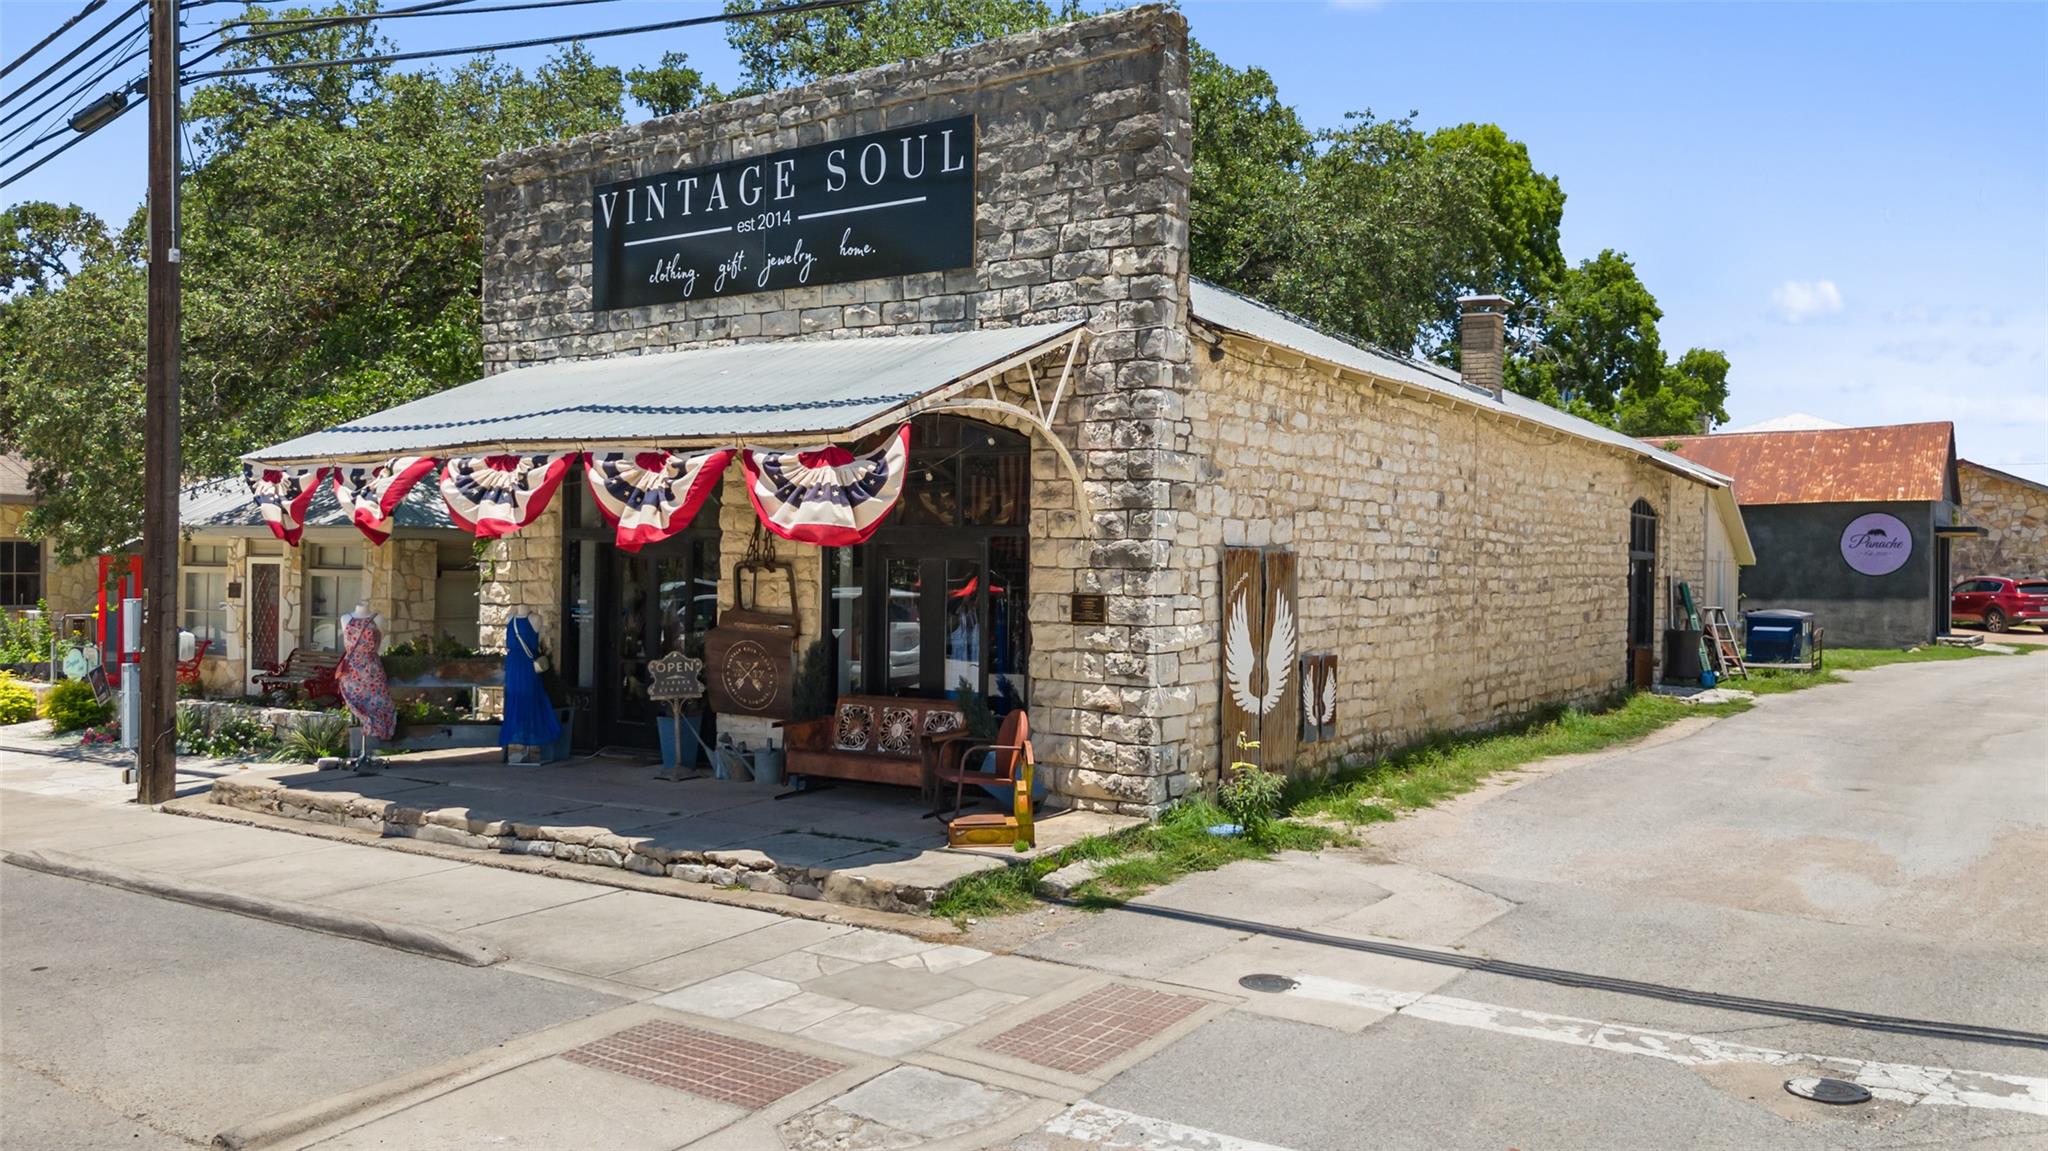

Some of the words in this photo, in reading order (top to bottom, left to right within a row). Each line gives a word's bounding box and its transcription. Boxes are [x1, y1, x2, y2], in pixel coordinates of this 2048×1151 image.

[599, 158, 796, 229] VINTAGE
[826, 129, 965, 193] SOUL
[737, 218, 755, 233] est
[758, 210, 791, 230] 2014
[649, 253, 700, 297] clothing.
[714, 250, 747, 292] gift.
[757, 238, 817, 288] jewelry.
[839, 227, 876, 257] home.
[1848, 533, 1903, 549] Panache
[655, 661, 694, 673] OPEN
